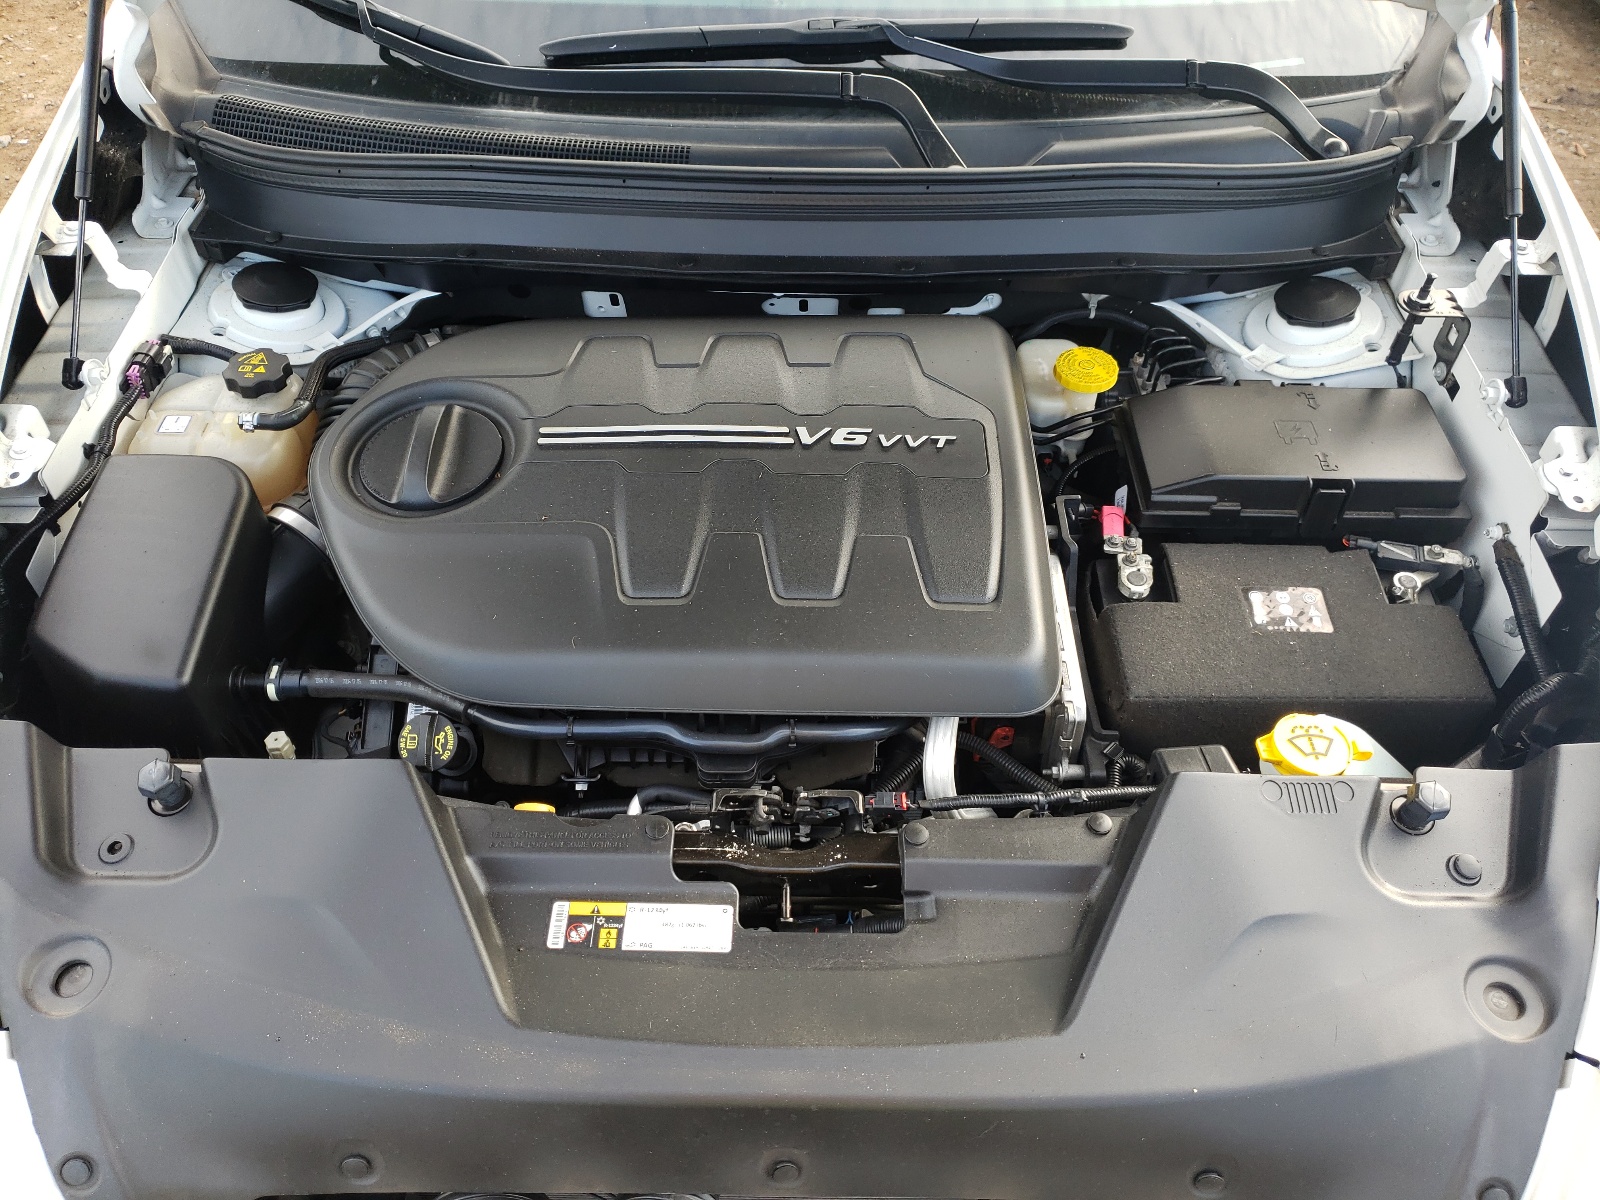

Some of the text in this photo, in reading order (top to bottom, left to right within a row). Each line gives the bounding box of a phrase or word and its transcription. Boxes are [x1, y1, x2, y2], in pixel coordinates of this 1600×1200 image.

[796, 427, 957, 448] V6 VVT
[440, 725, 454, 761] ENGINE OIL
